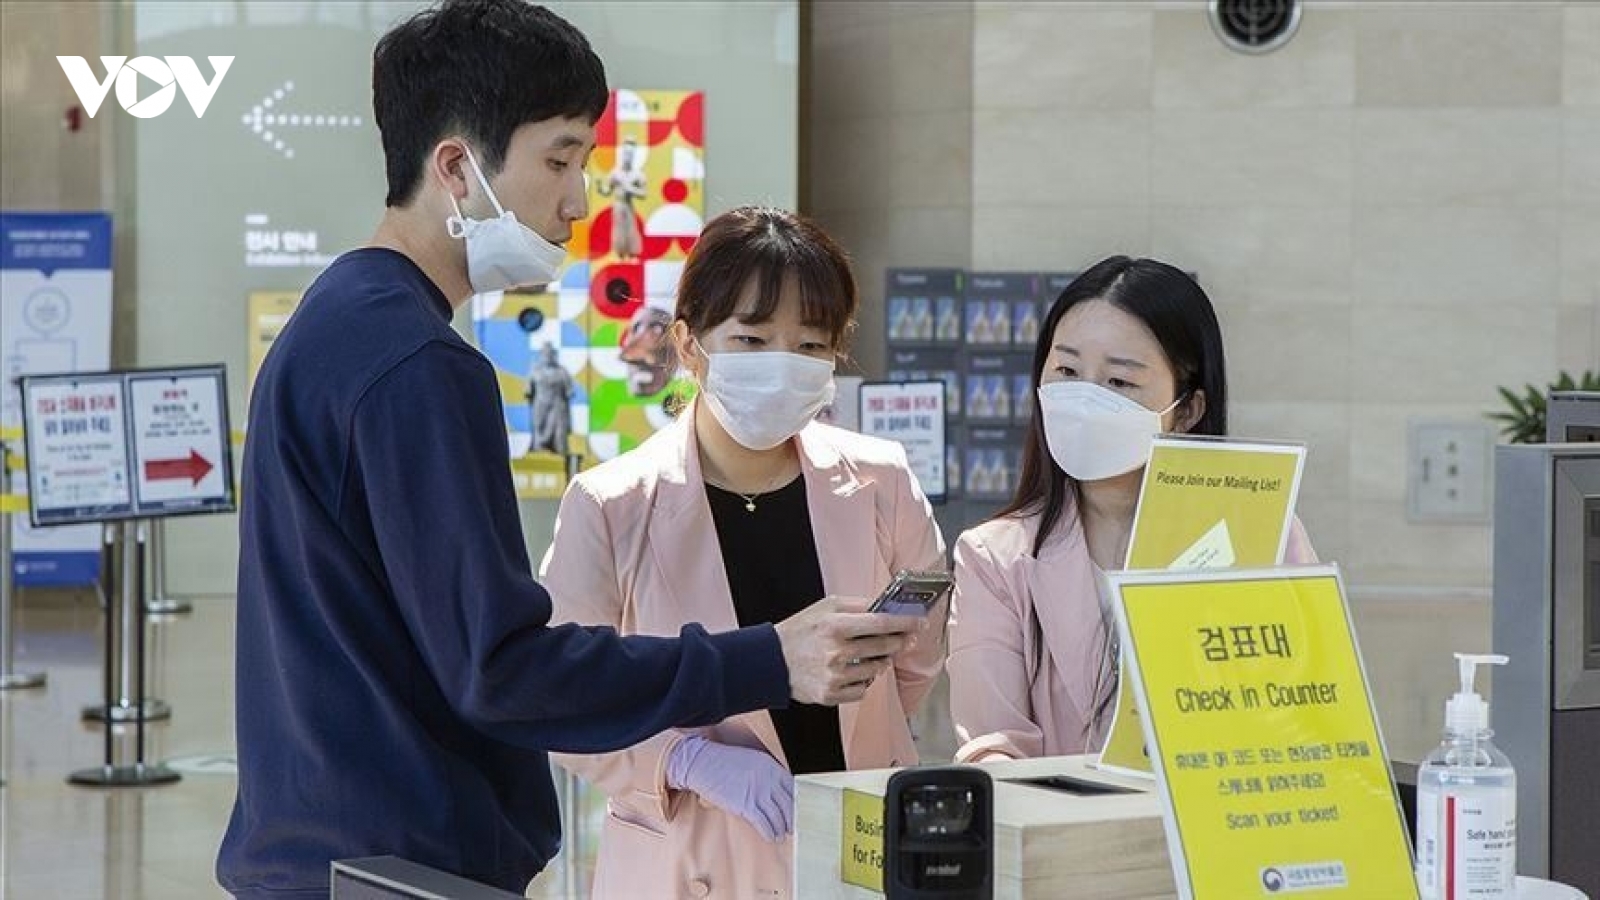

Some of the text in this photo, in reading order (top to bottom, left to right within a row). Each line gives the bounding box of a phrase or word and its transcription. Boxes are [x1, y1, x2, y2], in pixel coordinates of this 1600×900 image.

[1156, 471, 1282, 493] Please Join our Mailing List!
[1198, 624, 1291, 662] 검표대
[1175, 682, 1338, 714] Check in Counter
[1226, 804, 1340, 830] Scan your ticket!
[852, 844, 869, 864] for
